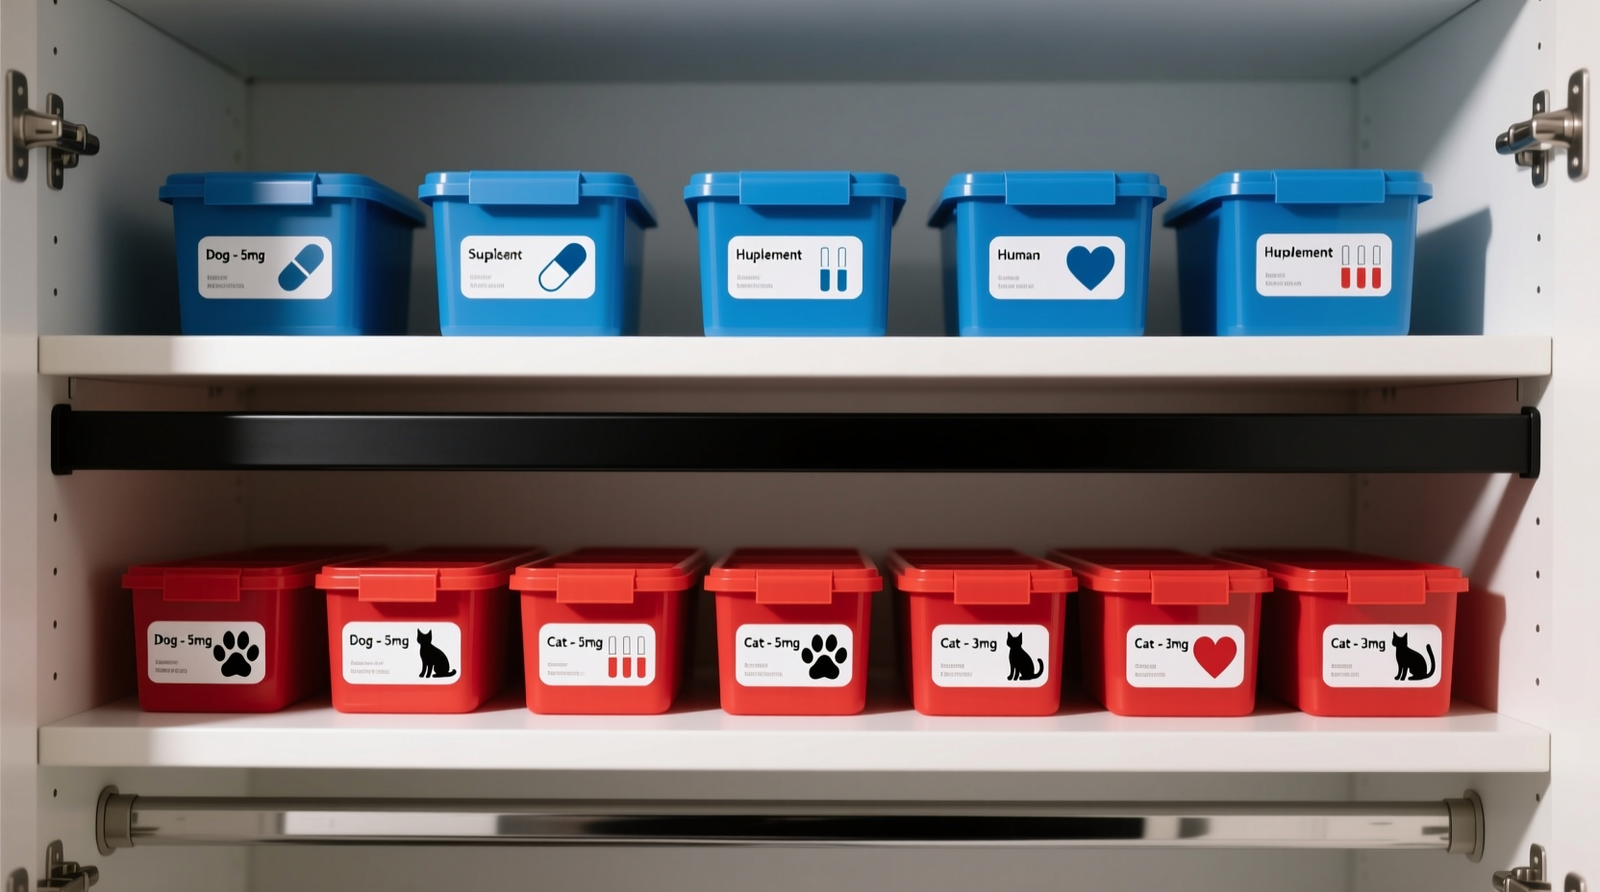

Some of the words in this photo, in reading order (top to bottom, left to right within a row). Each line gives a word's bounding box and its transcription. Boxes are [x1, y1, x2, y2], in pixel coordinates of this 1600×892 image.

[206, 248, 231, 264] Dog
[240, 248, 266, 265] 5mg
[736, 247, 803, 264] Huplement
[997, 248, 1041, 261] Human
[1264, 246, 1334, 262] Huplement
[154, 633, 178, 649] Dog
[187, 633, 213, 649] 5mg
[349, 633, 374, 650] Dog
[384, 634, 410, 650] 5mg
[546, 635, 568, 648] Cat
[578, 636, 604, 651] 5mg
[743, 636, 765, 649] Cat
[774, 636, 800, 652] 5mg
[940, 637, 961, 649] Cat
[971, 637, 998, 653] 3mg
[1134, 637, 1155, 649] Cat
[1165, 637, 1189, 653] 3mg
[1330, 637, 1351, 649] Cat
[1360, 637, 1386, 653] 3mg
